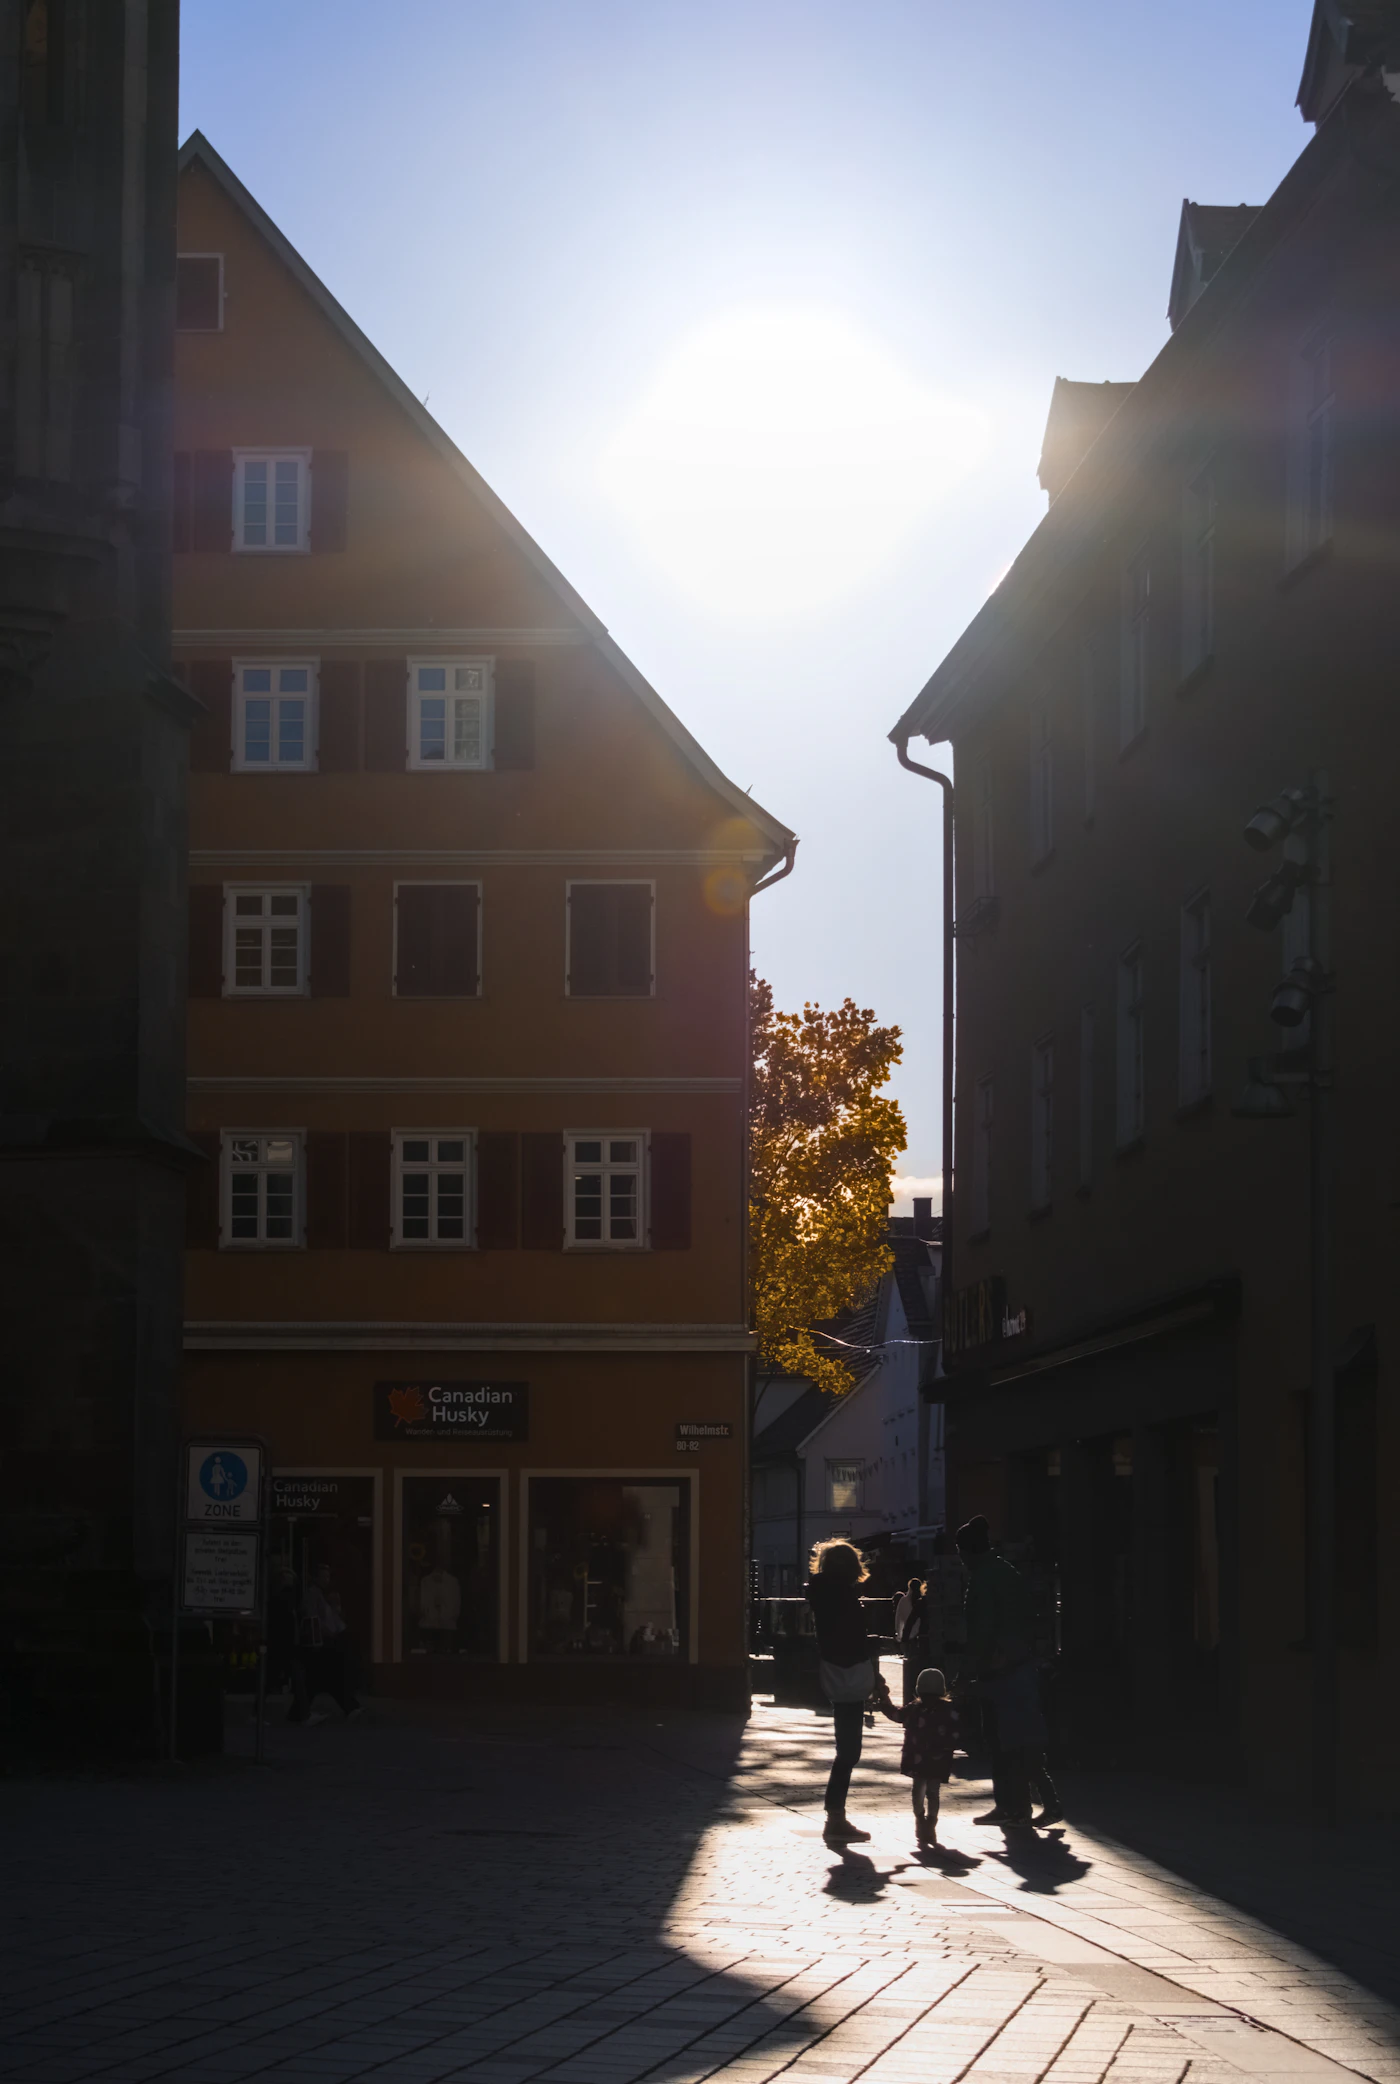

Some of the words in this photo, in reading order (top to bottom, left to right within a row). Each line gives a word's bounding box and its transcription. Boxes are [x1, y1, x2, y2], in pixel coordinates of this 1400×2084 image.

[428, 1386, 513, 1403] Canadian
[432, 1406, 489, 1427] Husky
[405, 1428, 435, 1436] Wander-
[437, 1428, 451, 1436] und
[452, 1428, 513, 1438] Reiseausrüstung
[679, 1424, 729, 1435] Wilhelmstr.
[676, 1441, 699, 1451] 80-82
[273, 1479, 338, 1493] Canadian
[276, 1494, 320, 1511] Husky
[204, 1504, 241, 1517] ZONE
